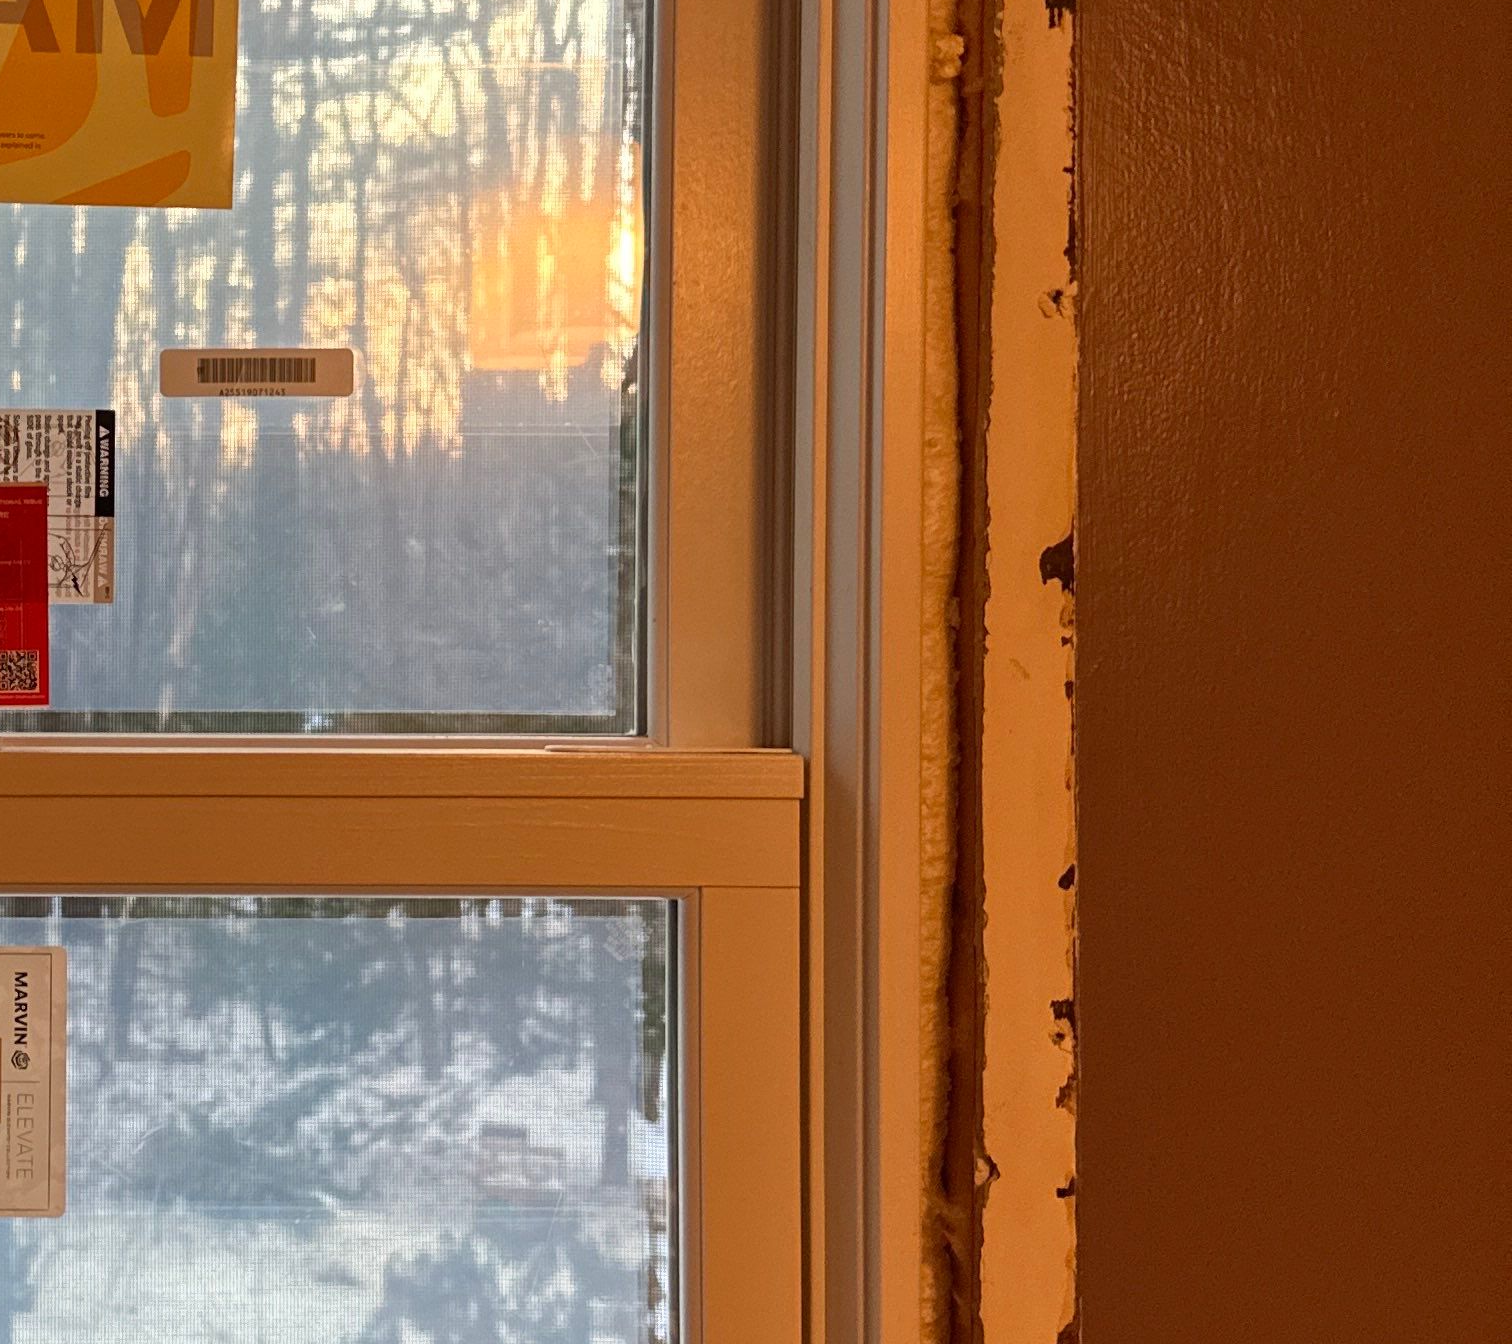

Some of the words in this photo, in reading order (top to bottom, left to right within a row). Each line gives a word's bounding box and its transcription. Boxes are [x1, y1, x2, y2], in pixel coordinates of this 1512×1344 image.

[99, 438, 110, 498] WARNING
[14, 971, 29, 1045] MARVIN
[16, 1094, 35, 1180] ELEVATE
